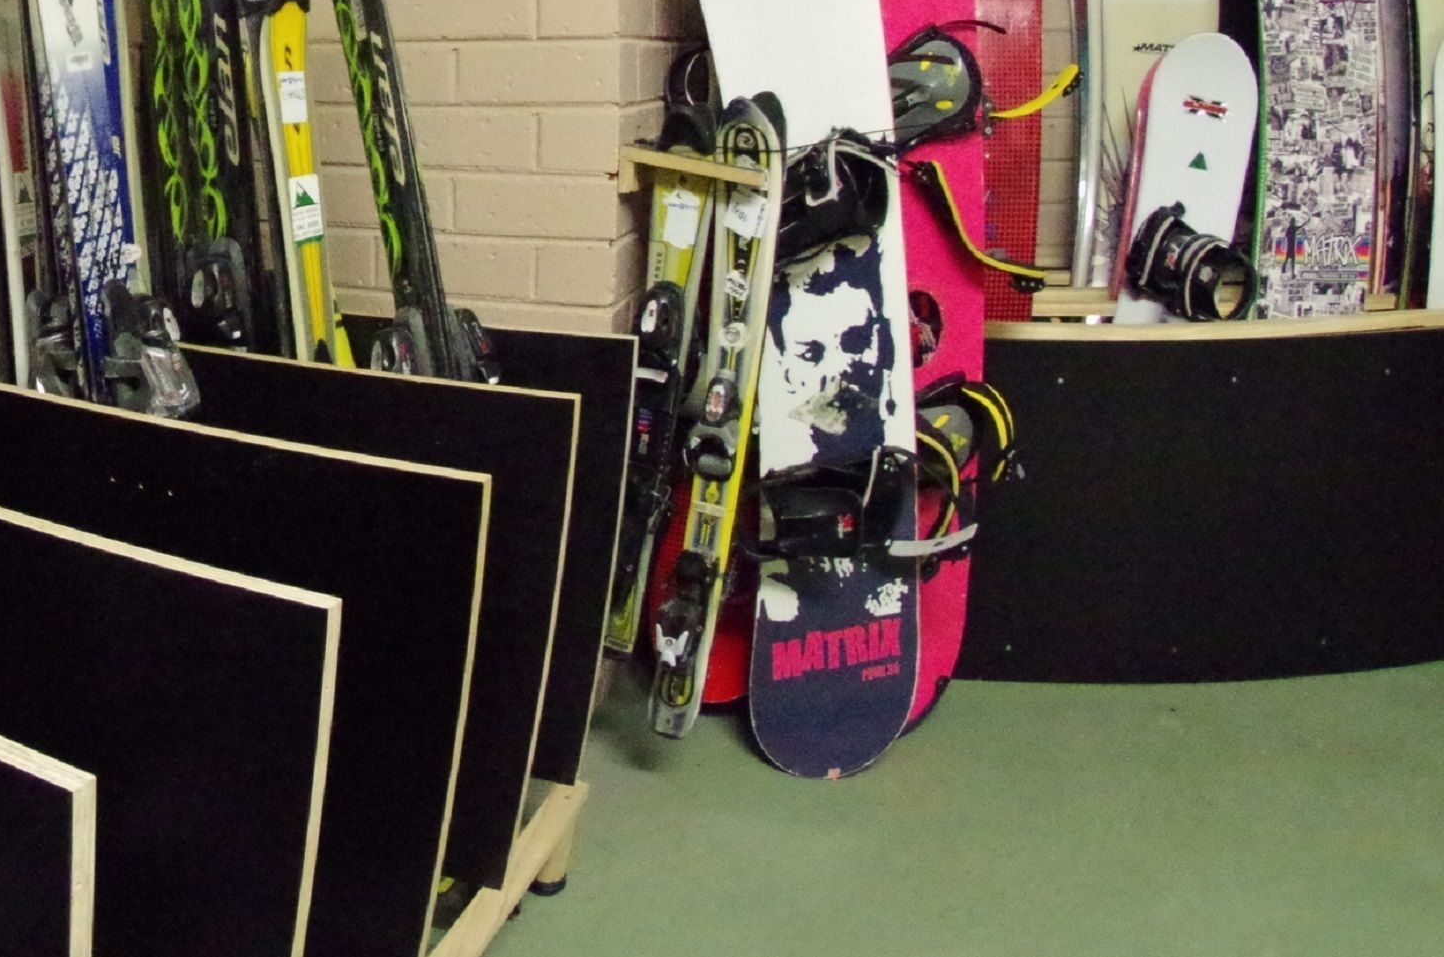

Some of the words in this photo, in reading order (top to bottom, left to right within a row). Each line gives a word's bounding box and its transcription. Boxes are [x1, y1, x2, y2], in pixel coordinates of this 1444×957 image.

[213, 11, 241, 167] elan
[370, 30, 406, 187] elan
[771, 619, 903, 682] MATRIX
